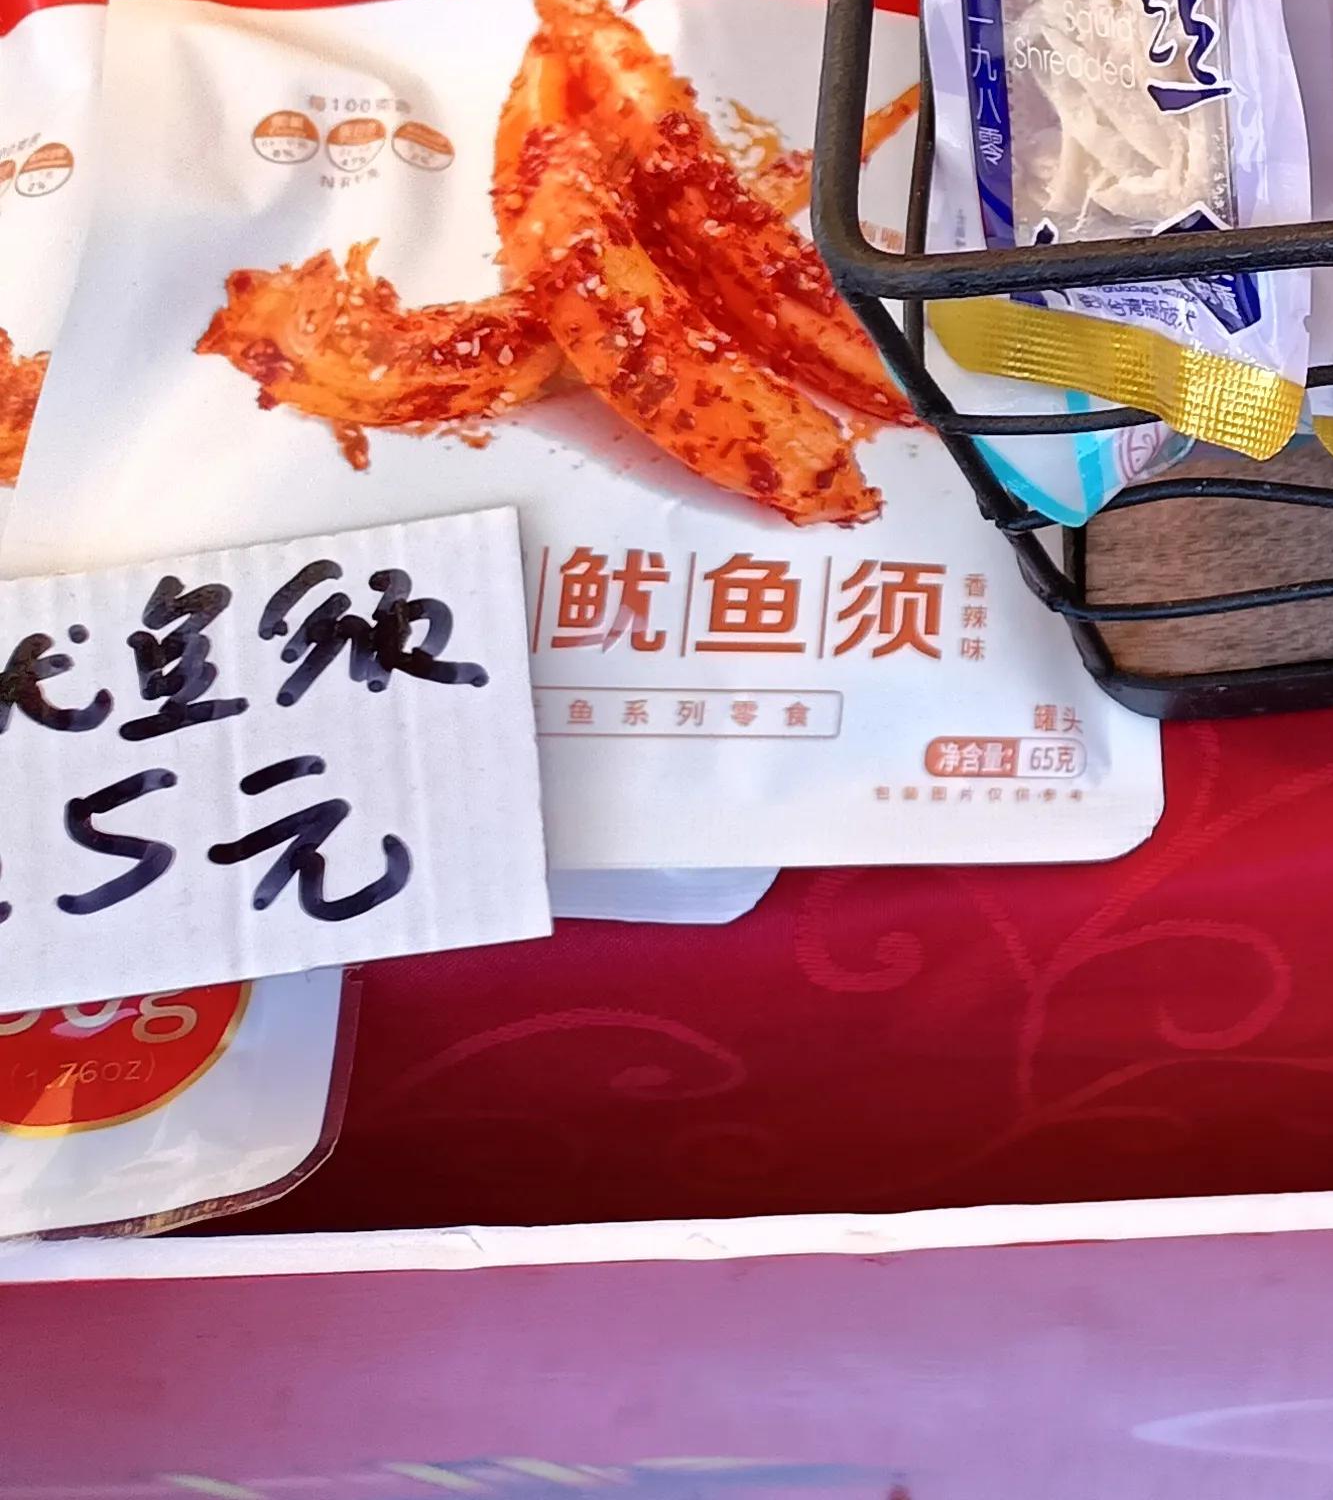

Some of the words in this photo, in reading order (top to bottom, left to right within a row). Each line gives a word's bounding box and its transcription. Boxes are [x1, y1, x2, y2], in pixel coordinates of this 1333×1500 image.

[1064, 3, 1135, 41] Squid
[1013, 41, 1137, 88] Shredded
[961, 572, 989, 661] 香辣味
[536, 698, 811, 728] 鱼系列零食
[1033, 703, 1084, 734] 罐头
[1028, 744, 1078, 775] 65克
[0, 755, 412, 924] 5元
